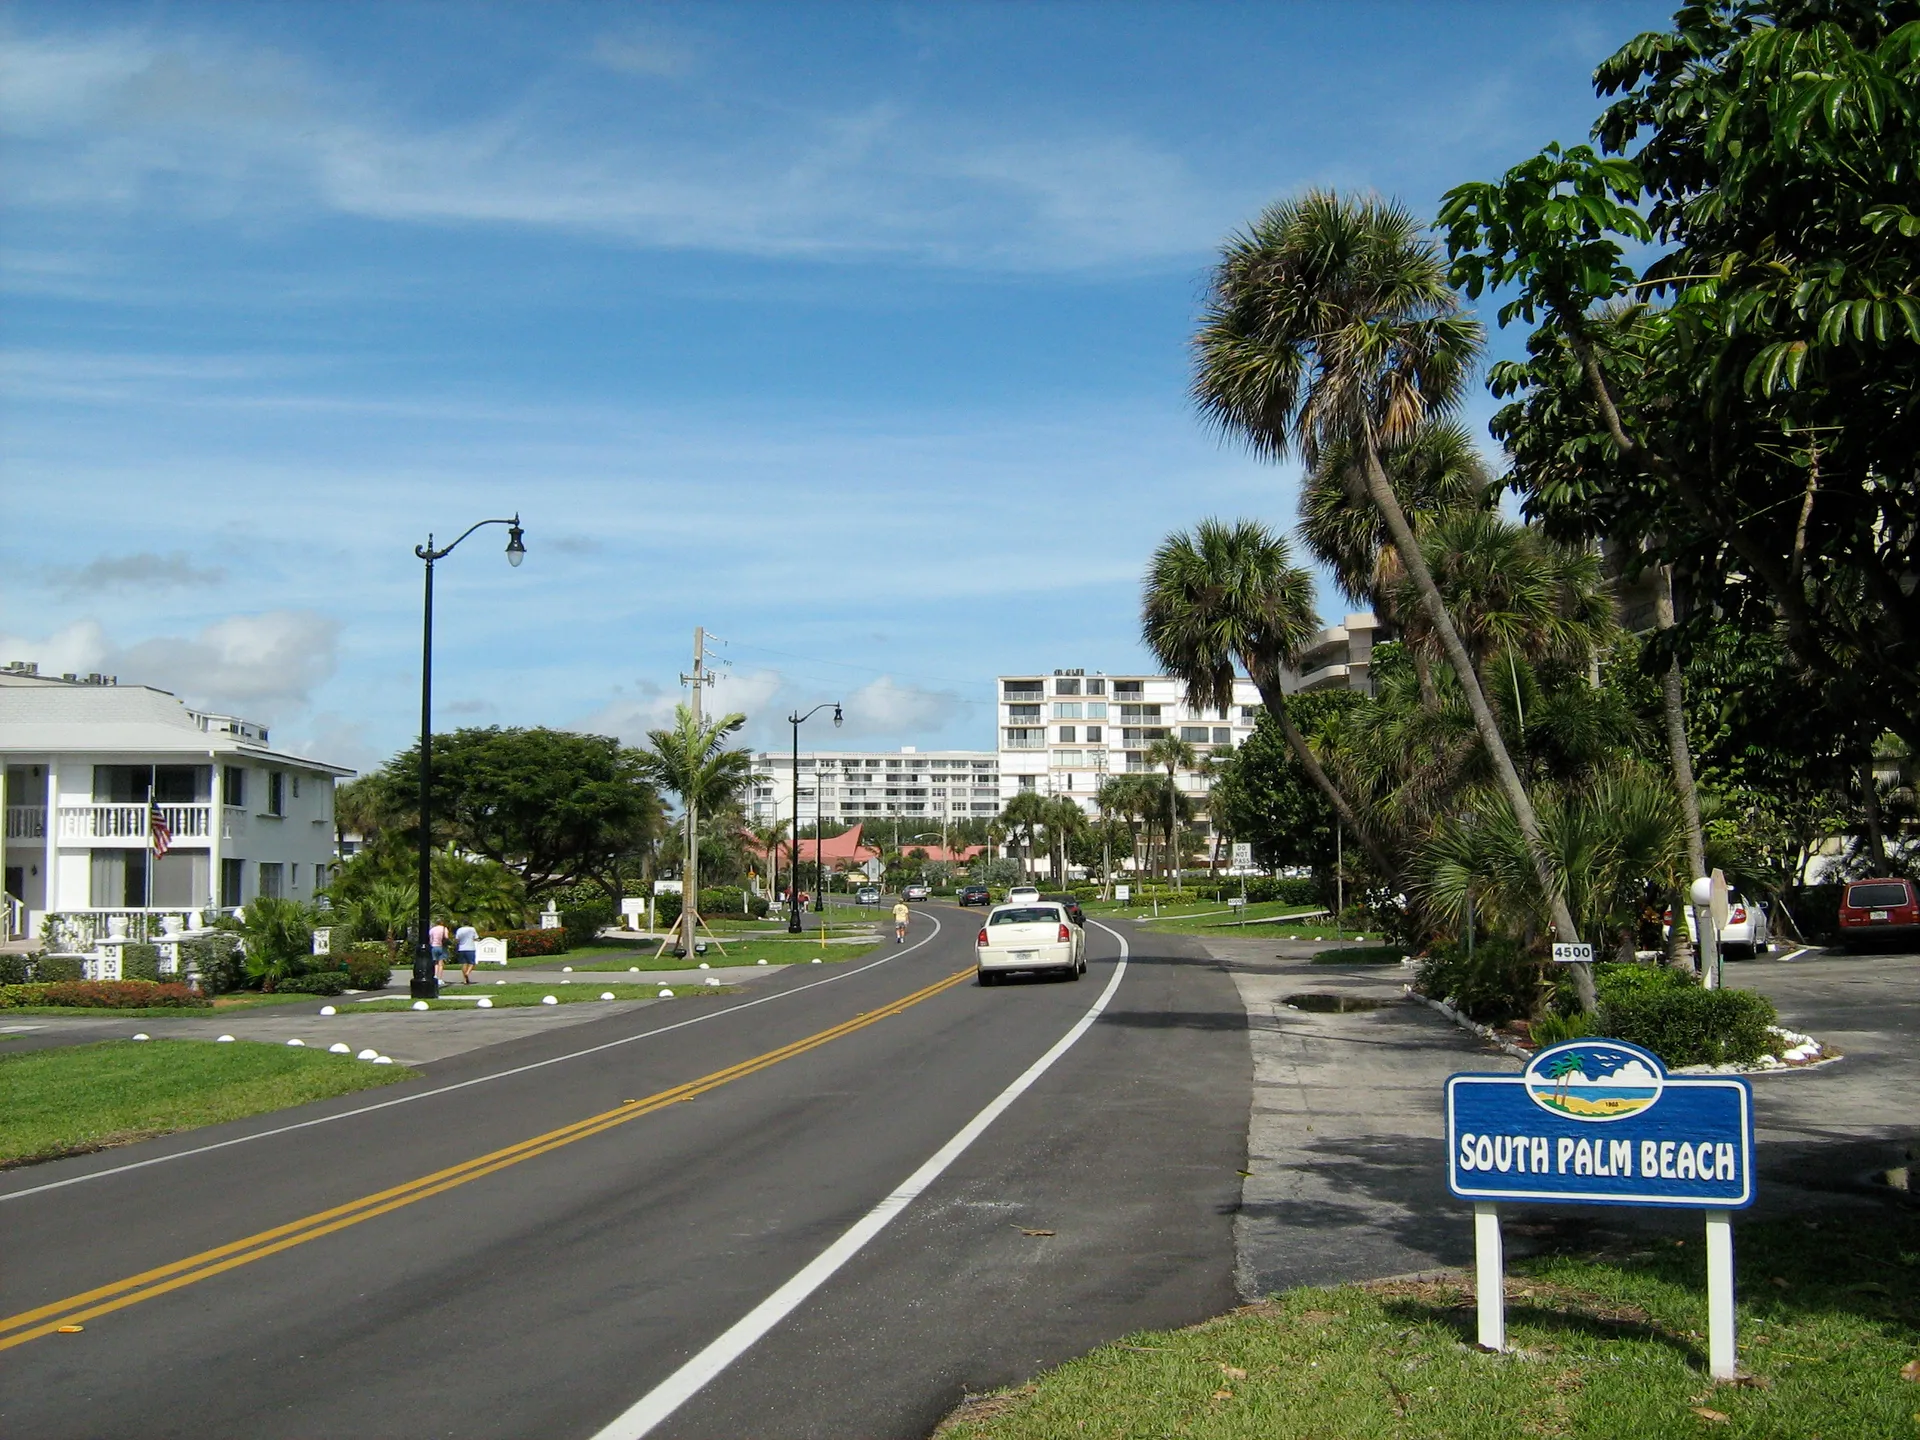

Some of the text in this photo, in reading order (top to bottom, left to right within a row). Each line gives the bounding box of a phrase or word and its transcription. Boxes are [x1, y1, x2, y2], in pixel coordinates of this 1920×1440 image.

[1554, 947, 1590, 958] 4500
[1459, 1132, 1735, 1181] SOUTH PALM BEACH
